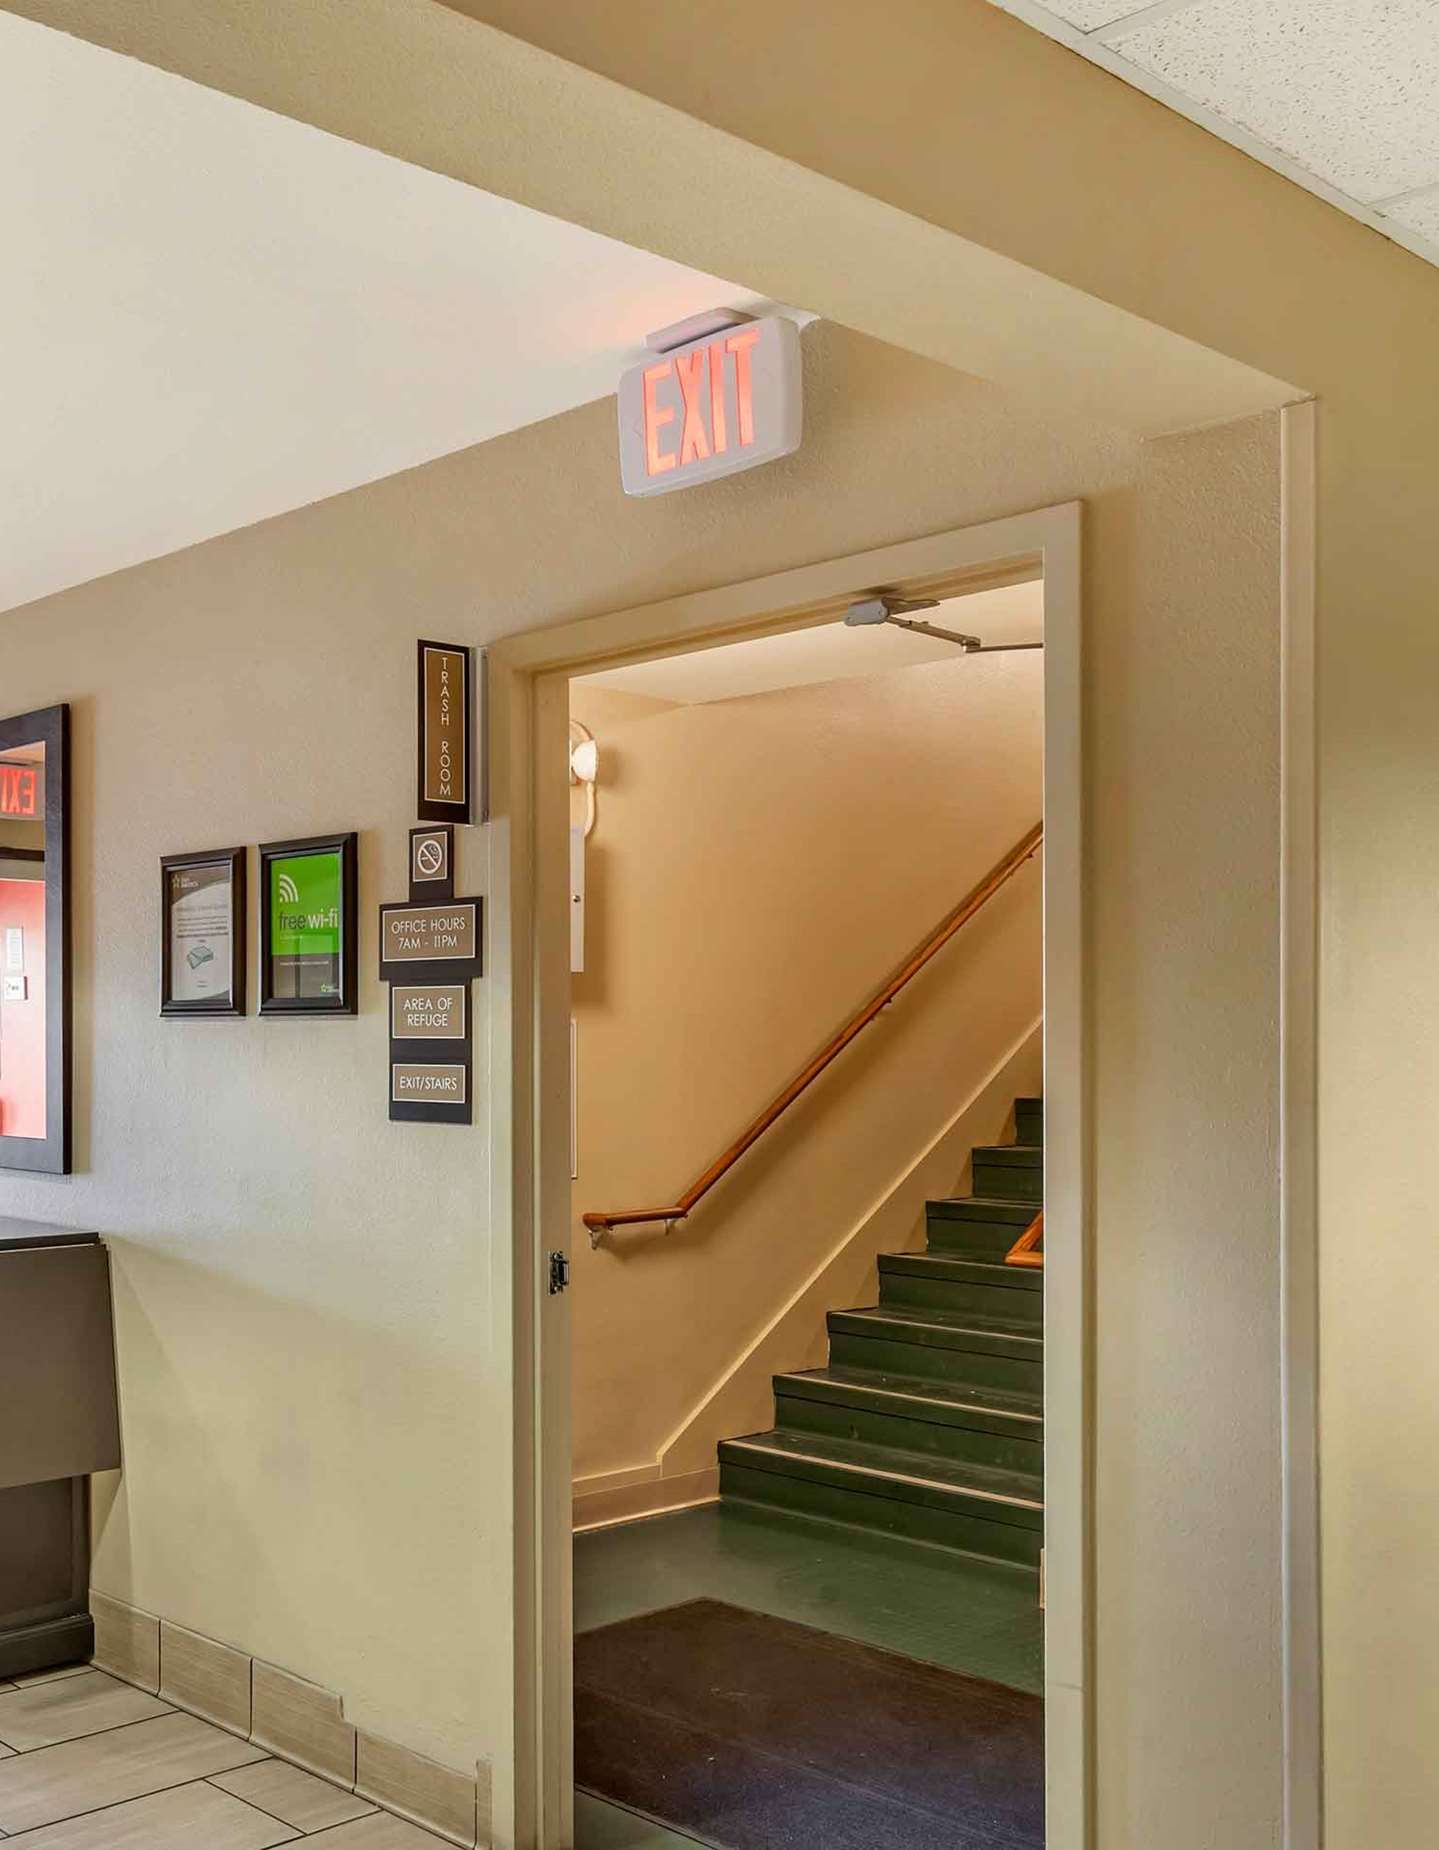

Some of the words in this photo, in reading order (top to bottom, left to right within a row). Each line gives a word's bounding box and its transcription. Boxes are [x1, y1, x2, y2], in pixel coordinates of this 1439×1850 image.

[643, 328, 760, 476] EXIT
[440, 657, 450, 726] TRASH
[440, 741, 451, 796] ROOM
[280, 911, 305, 930] free
[308, 908, 338, 928] wi-fi
[391, 919, 427, 934] OFFICE
[430, 916, 466, 932] HOURS
[398, 936, 421, 950] 7AM
[434, 935, 457, 948] 11PM
[403, 998, 433, 1011] AREA
[437, 997, 453, 1011] OF
[407, 1013, 449, 1027] REFUGE
[399, 1075, 457, 1091] EXIT/STAIRS
